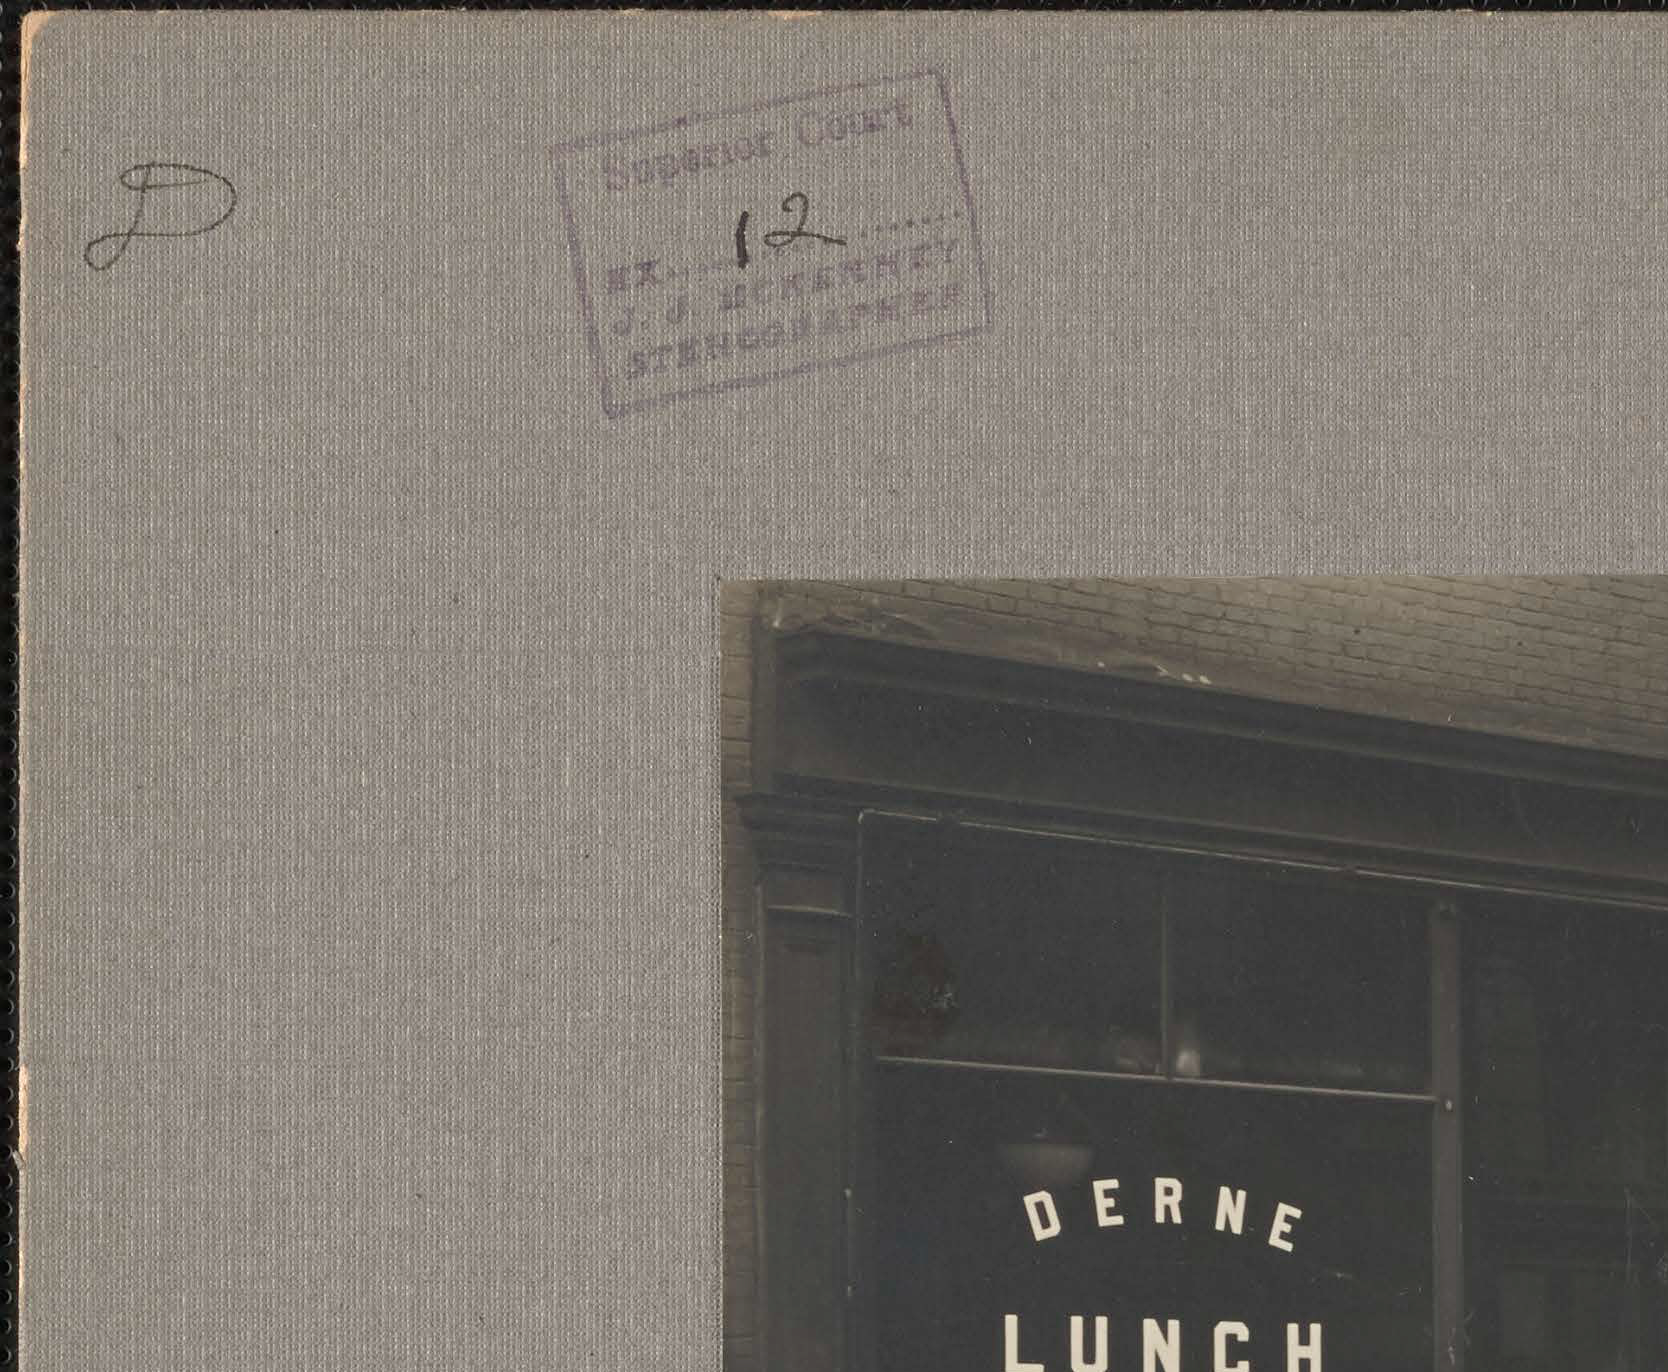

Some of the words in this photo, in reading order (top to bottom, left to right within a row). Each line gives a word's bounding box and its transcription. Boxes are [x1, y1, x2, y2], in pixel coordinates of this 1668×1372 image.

[603, 128, 775, 192] Superior
[797, 98, 914, 148] Court
[733, 190, 848, 271] 12
[1023, 1176, 1303, 1253] DERNE
